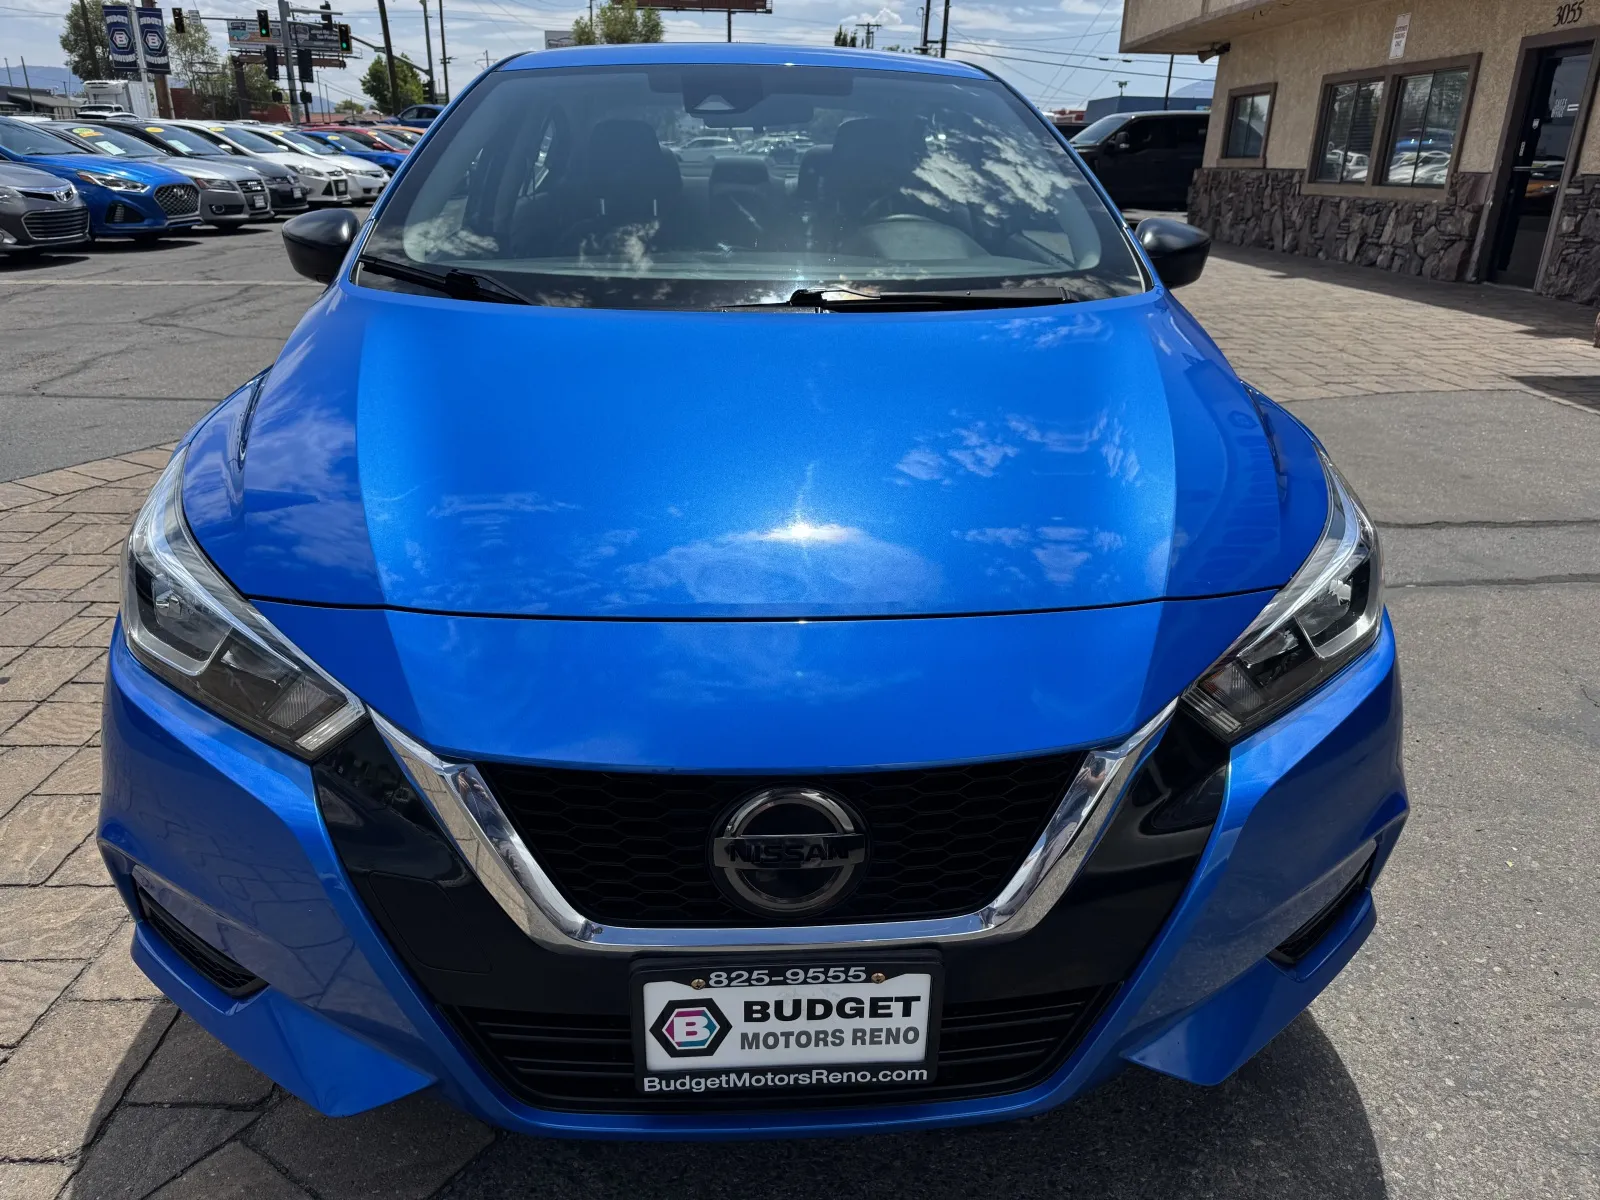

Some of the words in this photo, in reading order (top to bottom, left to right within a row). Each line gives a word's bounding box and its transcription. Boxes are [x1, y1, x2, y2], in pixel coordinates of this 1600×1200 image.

[140, 16, 161, 26] BUDGET
[1553, 0, 1585, 27] 3055
[729, 844, 849, 863] NISSAN
[708, 966, 867, 988] 825-9555
[743, 996, 921, 1023] BUDGET
[674, 1015, 711, 1043] B
[740, 1028, 845, 1050] MOTORS
[851, 1026, 920, 1046] RENO
[643, 1069, 928, 1093] BudgetMotorsReno.com
